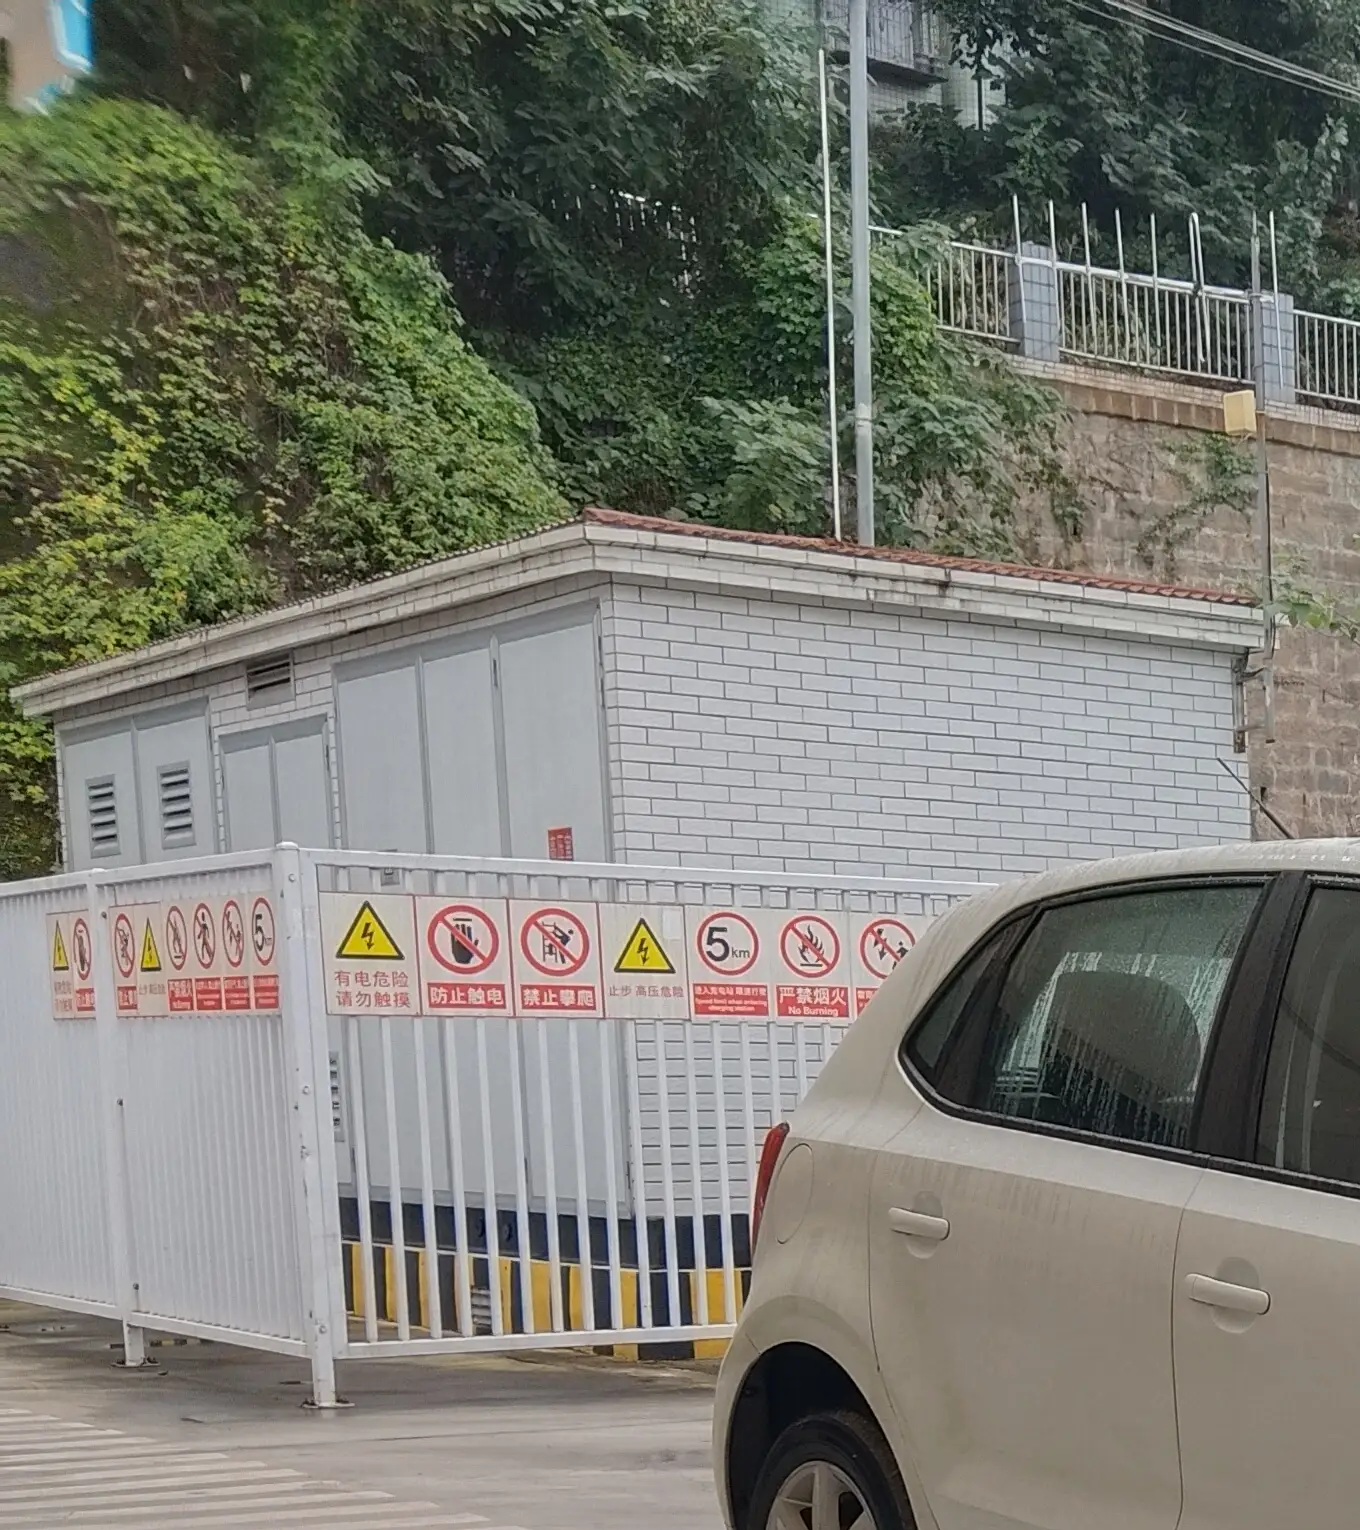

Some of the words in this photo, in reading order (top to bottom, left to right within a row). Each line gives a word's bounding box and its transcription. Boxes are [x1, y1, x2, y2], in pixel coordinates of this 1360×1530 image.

[334, 970, 409, 988] 有电危险
[336, 991, 411, 1009] 请勿触摸
[430, 986, 504, 1006] 防止触电
[523, 988, 594, 1007] 禁止攀爬
[779, 987, 846, 1006] 严禁烟火
[788, 1006, 801, 1015] No
[803, 1006, 838, 1017] Burning
